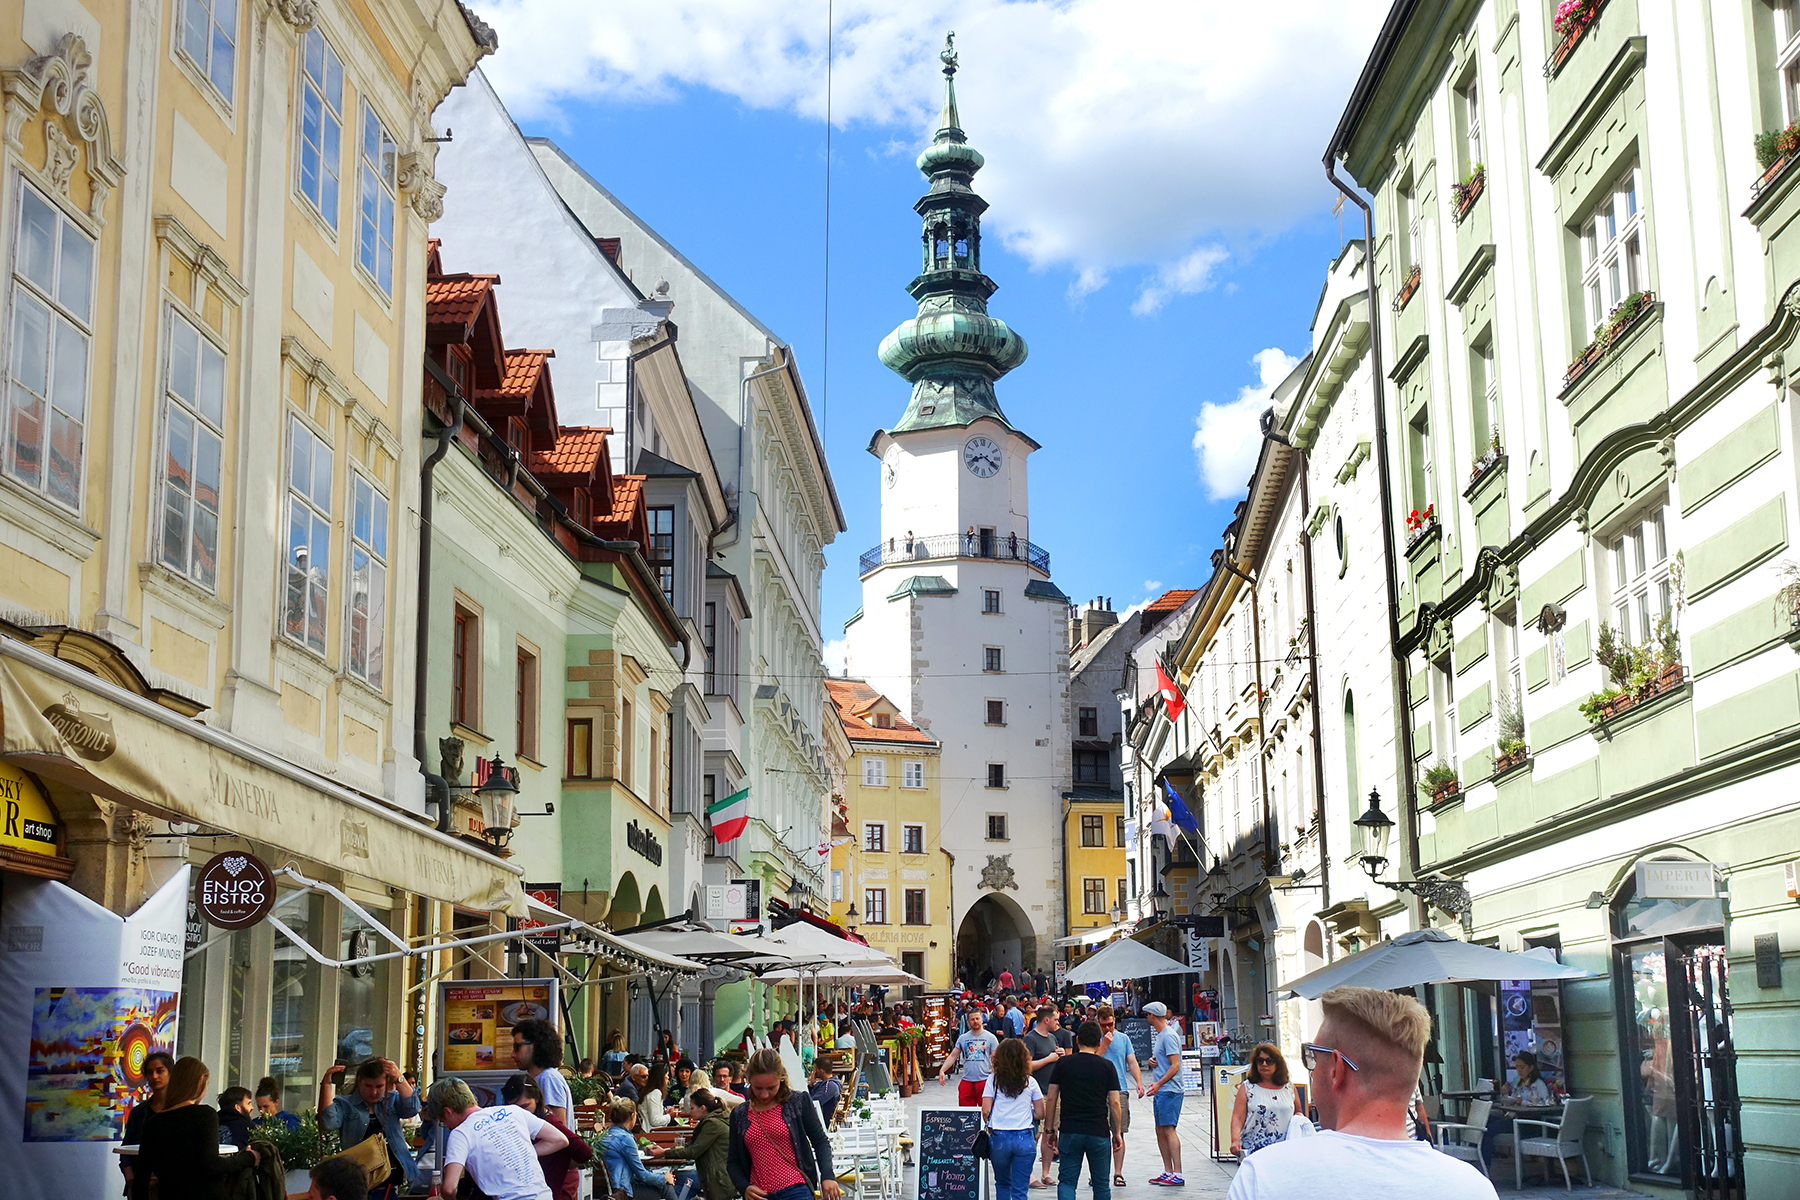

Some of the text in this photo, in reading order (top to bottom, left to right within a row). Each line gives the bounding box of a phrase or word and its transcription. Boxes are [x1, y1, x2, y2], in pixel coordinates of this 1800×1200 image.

[208, 769, 281, 825] MINERVA
[24, 823, 53, 841] art shop
[1646, 869, 1713, 881] IMPERIA
[203, 880, 265, 893] ENJOY
[1665, 884, 1694, 892] design
[202, 893, 265, 905] BISTRO
[141, 929, 156, 941] IGOR
[139, 945, 158, 957] JOZEF
